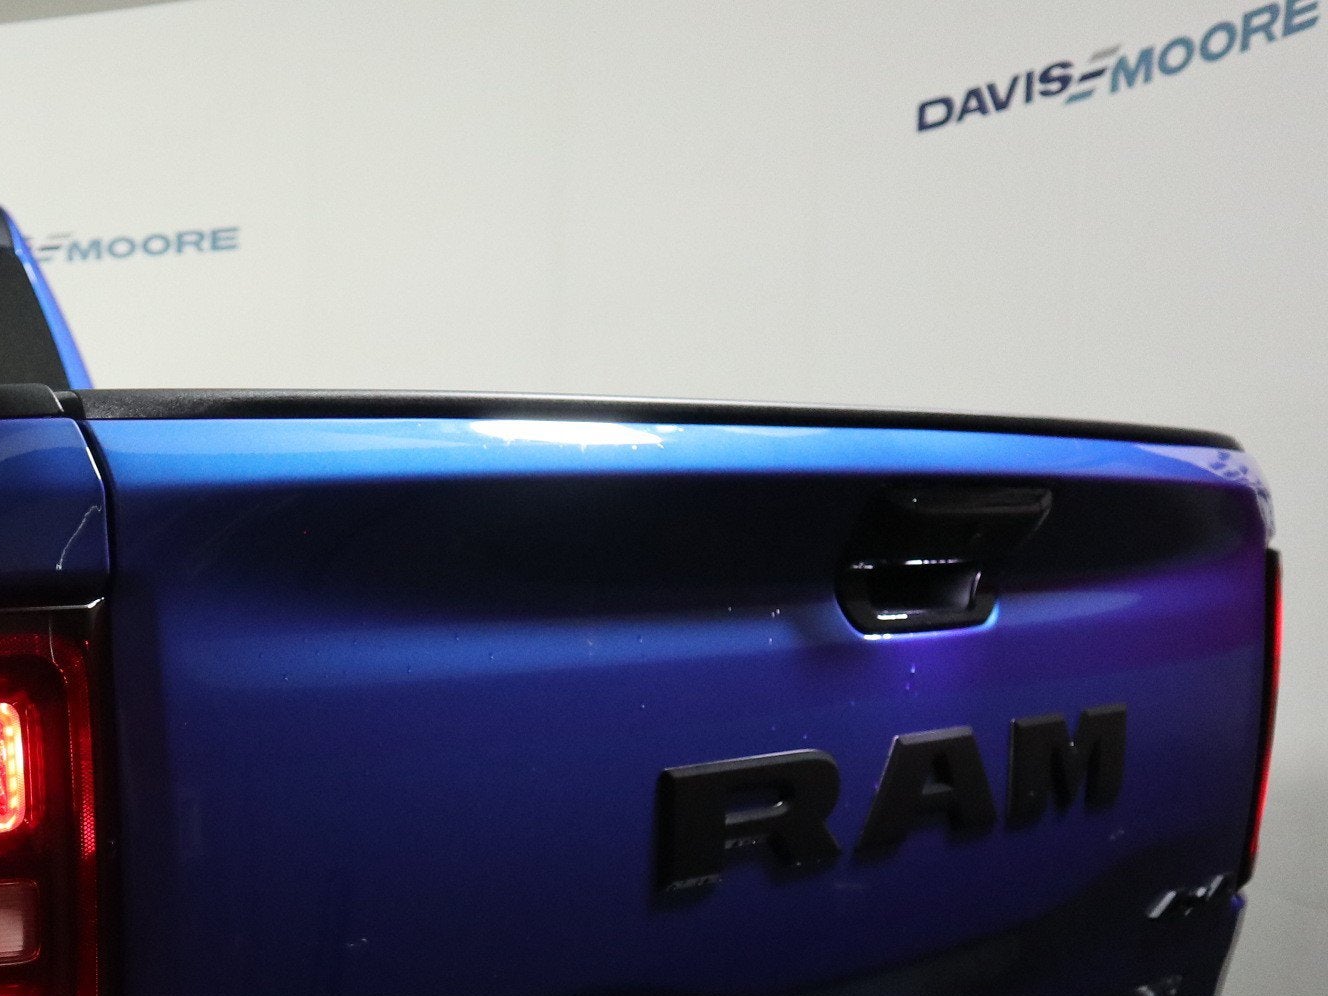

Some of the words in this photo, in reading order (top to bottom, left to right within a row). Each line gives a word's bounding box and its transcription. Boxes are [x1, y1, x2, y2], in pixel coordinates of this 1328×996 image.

[916, 60, 1074, 132] DAVIS
[1109, 0, 1321, 93] MOORE
[65, 226, 241, 262] MOORE
[653, 704, 1128, 902] RAM
